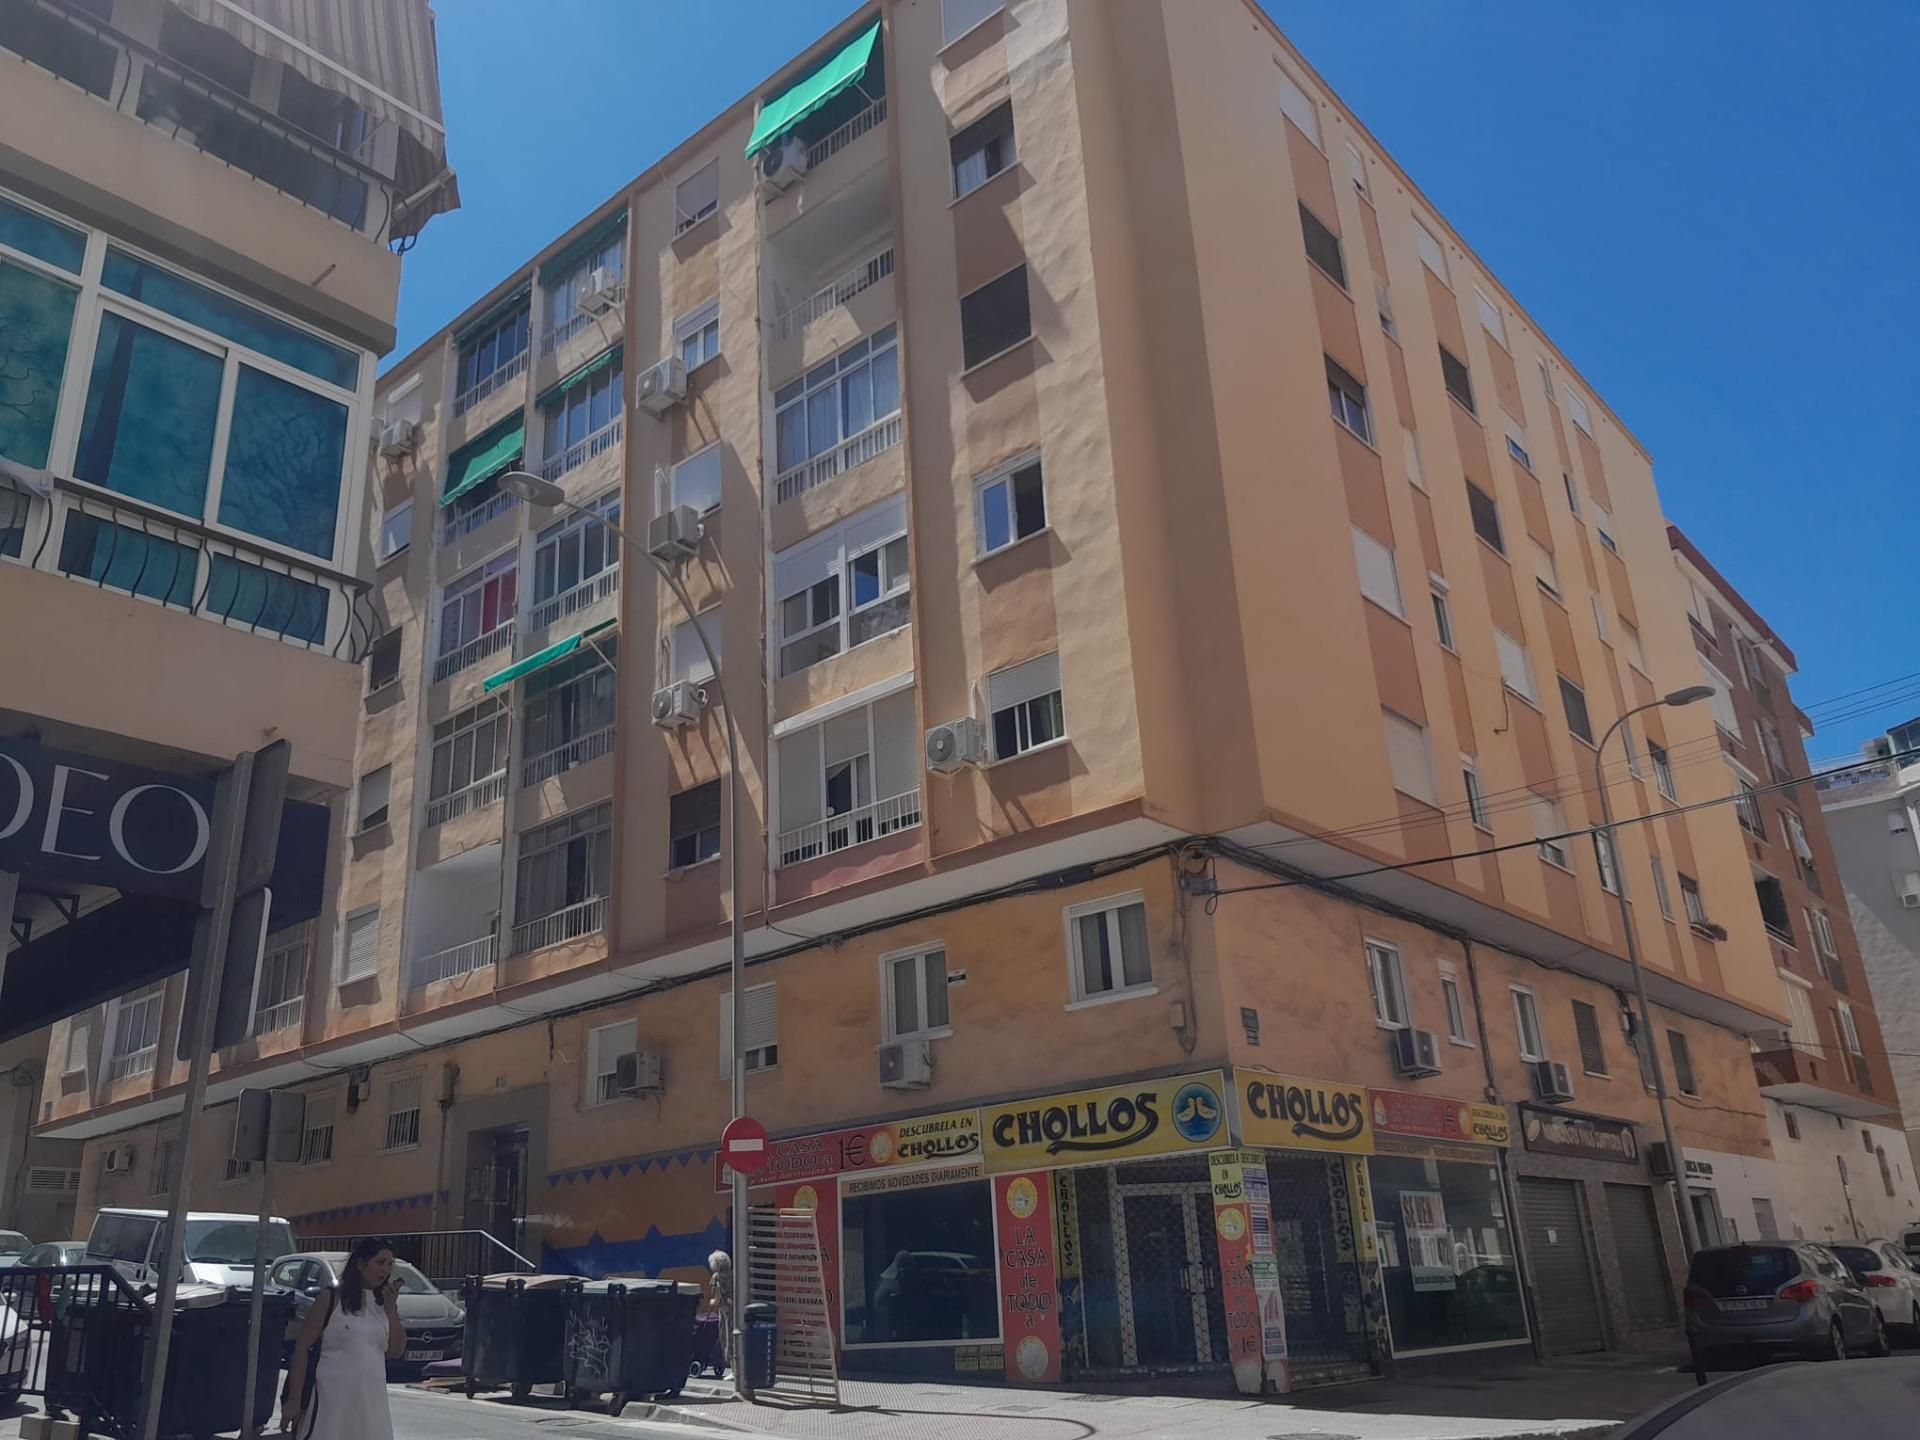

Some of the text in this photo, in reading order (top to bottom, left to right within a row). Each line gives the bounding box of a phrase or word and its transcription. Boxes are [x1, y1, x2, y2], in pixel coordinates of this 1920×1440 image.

[1247, 1081, 1364, 1141] CHOLLOS
[899, 1117, 973, 1138] DESCUBRELA EN
[992, 1093, 1159, 1154] CHOLLOS
[1472, 1122, 1508, 1142] CHOLLOS
[777, 1138, 825, 1156] CASA
[897, 1132, 979, 1159] CHOLLOS
[768, 1154, 817, 1172] TODO
[849, 1166, 979, 1193] RECIBIMOS NOVEDADES DIARIAMENTE
[1214, 1181, 1242, 1199] CHOLLOS
[1328, 1161, 1352, 1251] CHOLLOS
[1355, 1161, 1372, 1250] CHOLLS
[1058, 1175, 1074, 1267] CHOLLOS
[1016, 1226, 1035, 1246] LA
[1006, 1251, 1047, 1268] CASA
[1019, 1273, 1037, 1290] de
[1007, 1293, 1051, 1312] TODO
